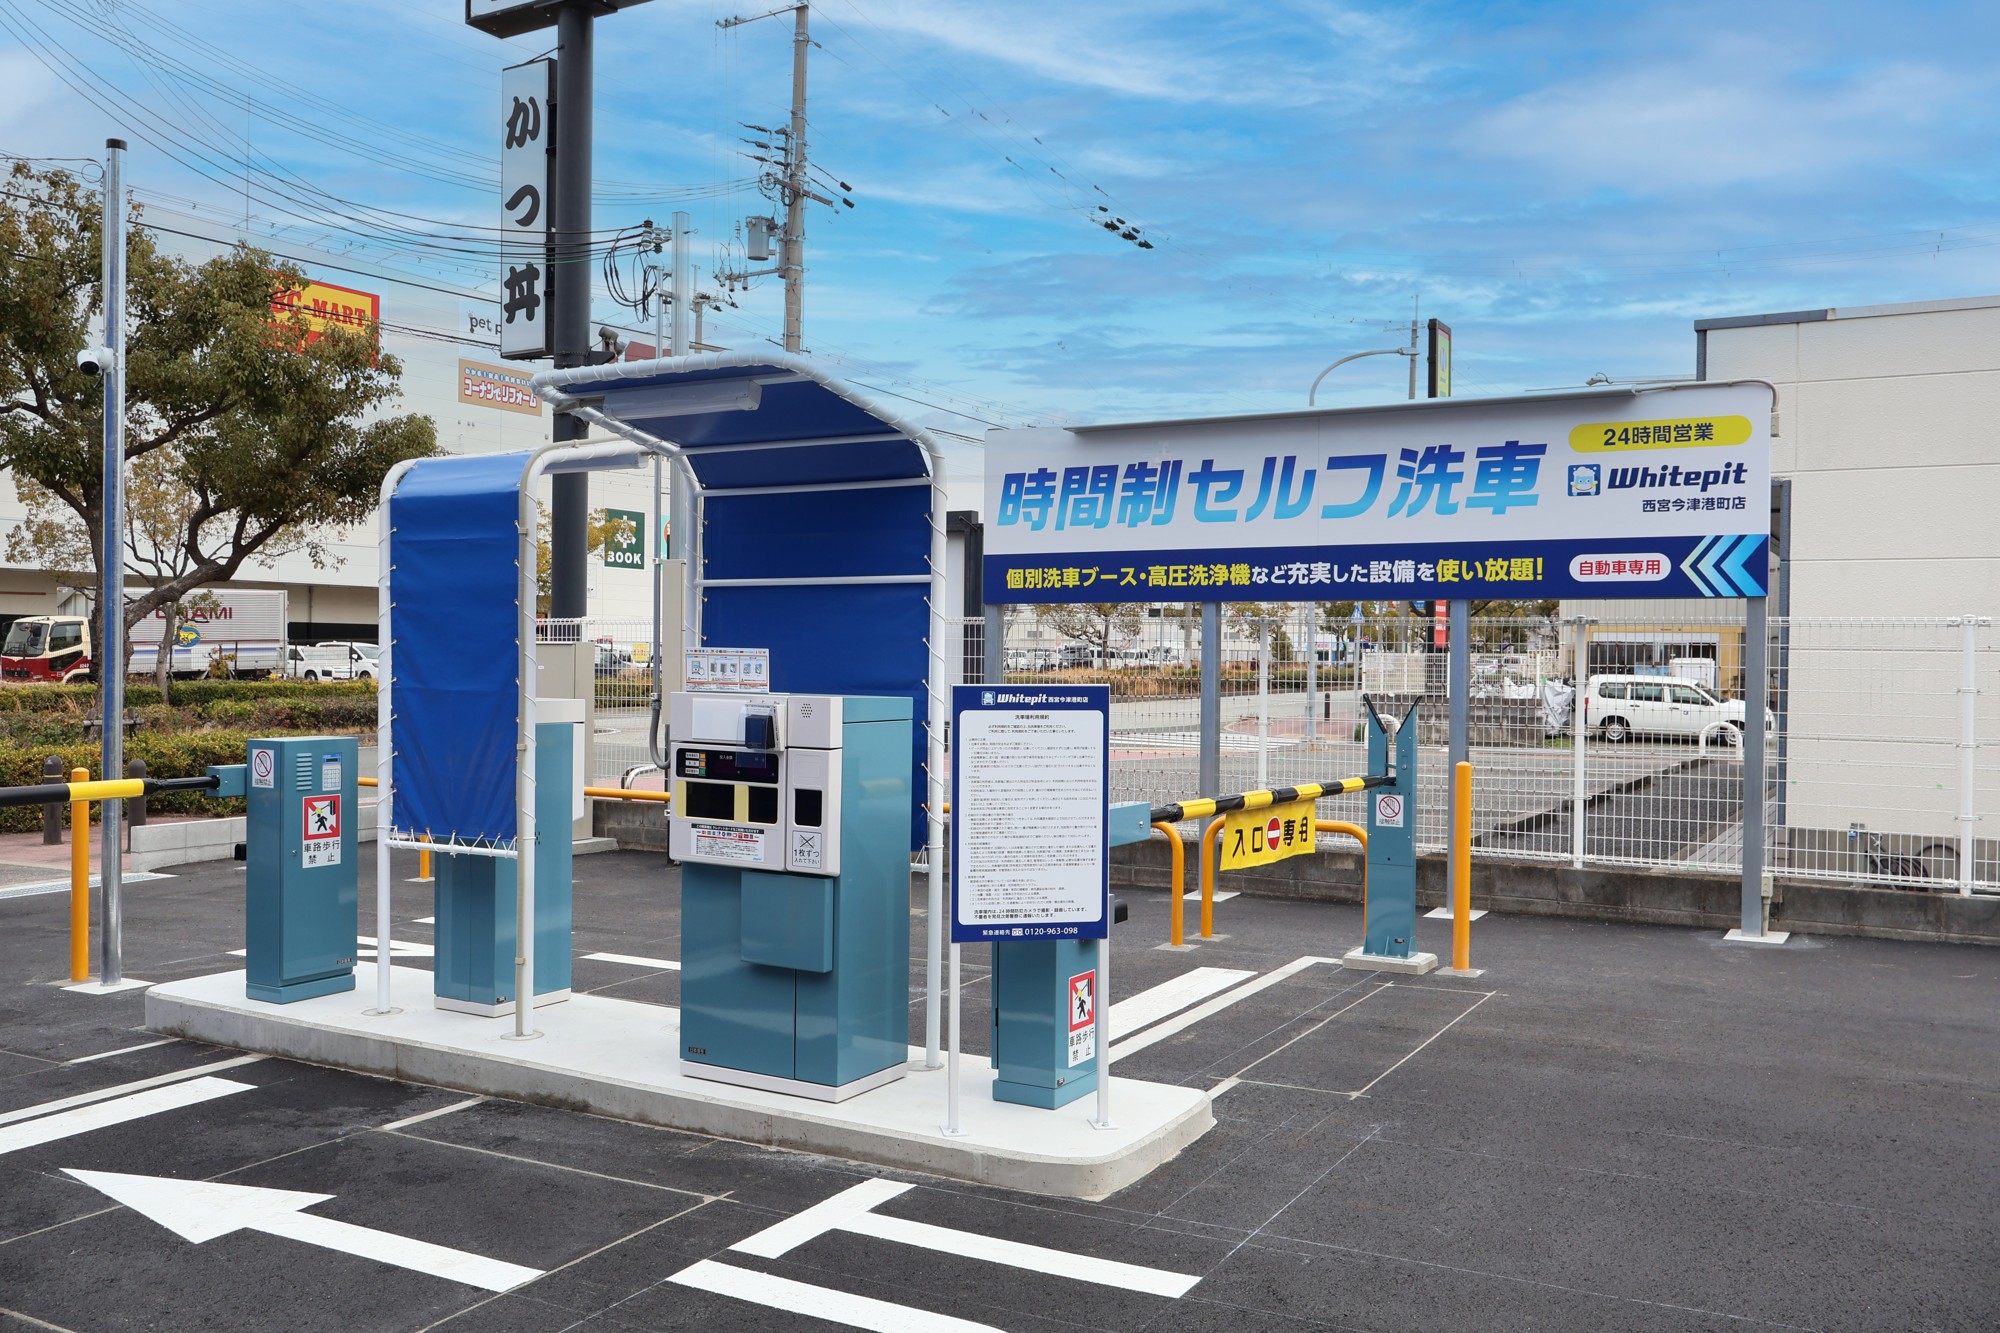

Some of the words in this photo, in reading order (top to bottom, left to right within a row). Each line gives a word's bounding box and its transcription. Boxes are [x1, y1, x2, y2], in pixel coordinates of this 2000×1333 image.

[504, 95, 541, 324] かつ丼
[270, 286, 366, 328] BC-MART
[464, 377, 537, 408] コーナンでリフォーム
[1603, 422, 1714, 446] 24時間営業
[997, 440, 1547, 531] 時間制セルフ洗車
[1607, 462, 1748, 492] Whitepit
[1642, 496, 1746, 512] 西宮今津港町店
[607, 550, 642, 565] BOOK
[1579, 559, 1661, 576] 自動車専用
[997, 693, 1048, 706] Whitepit
[1047, 696, 1089, 704] 西宮今津港町店
[303, 840, 341, 853] 車路歩行
[793, 849, 820, 858] 1枚ずつ
[1024, 927, 1078, 935] 0120-963-098
[1069, 1027, 1095, 1047] 車路歩行
